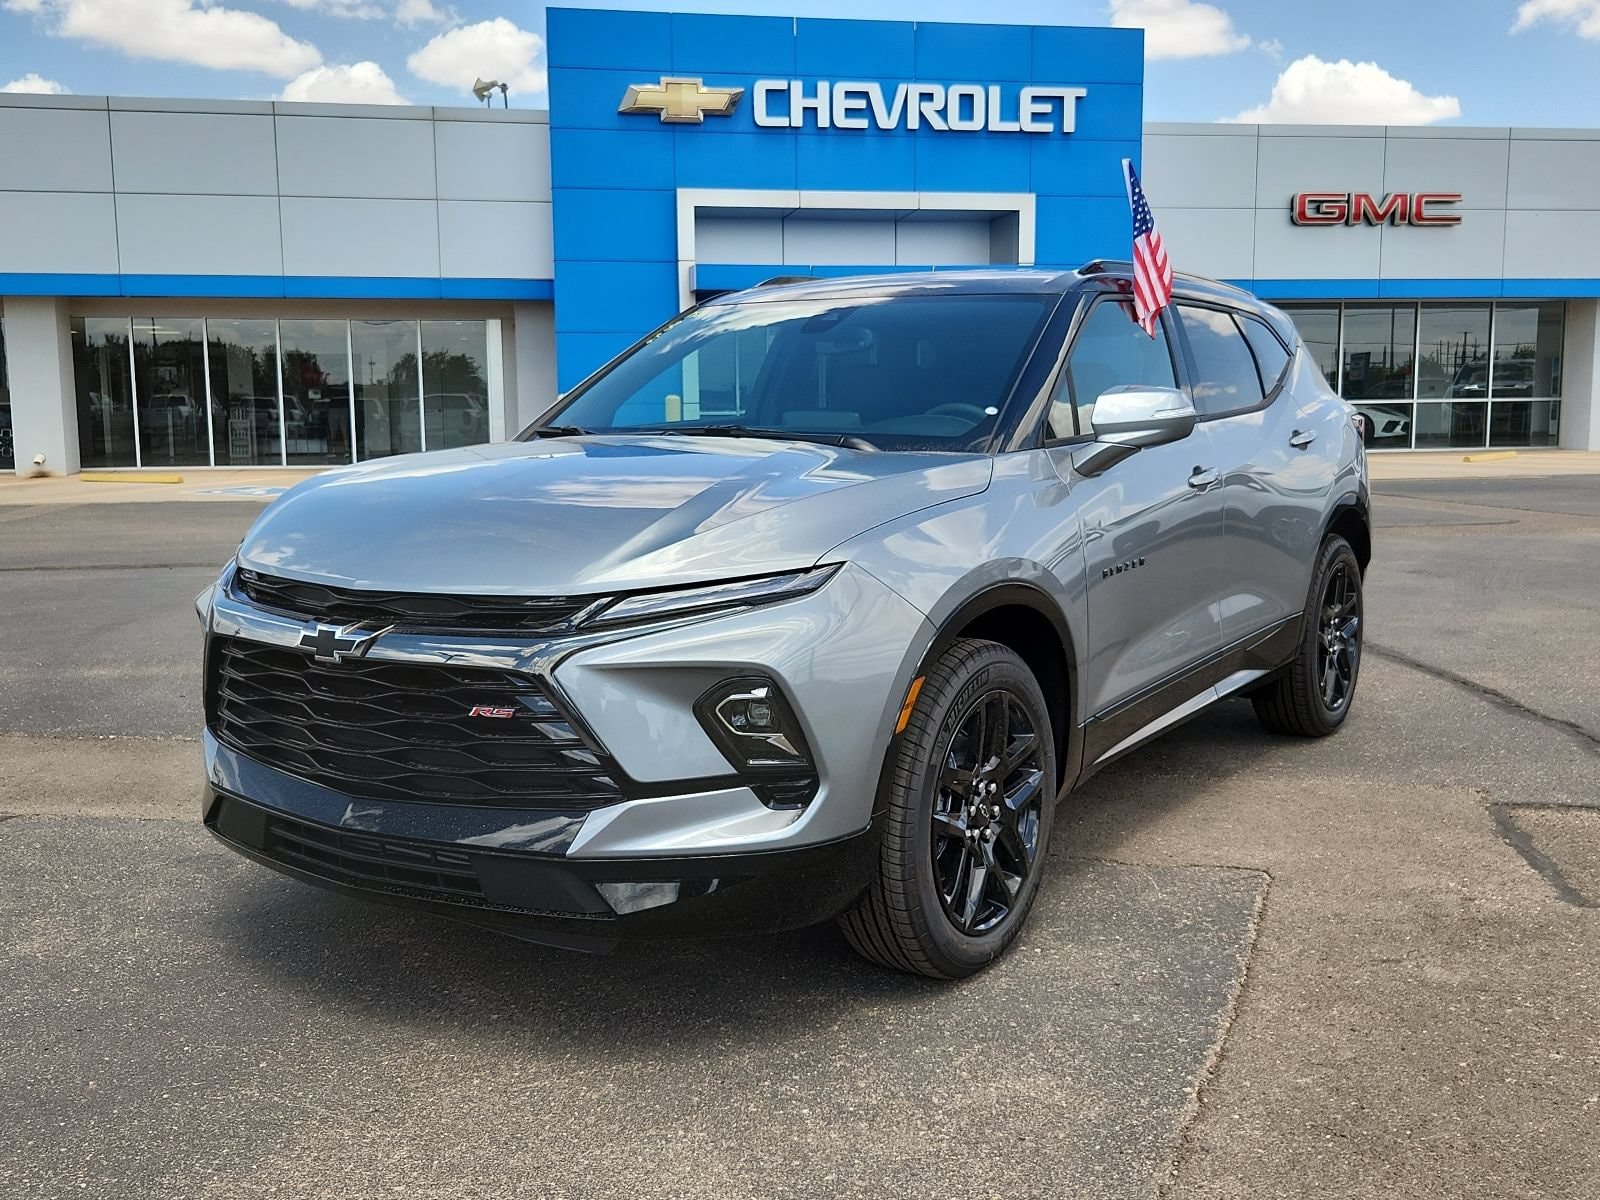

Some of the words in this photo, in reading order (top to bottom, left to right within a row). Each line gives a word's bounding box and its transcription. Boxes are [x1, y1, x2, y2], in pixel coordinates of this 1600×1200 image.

[753, 80, 1087, 133] CHEVROLET
[1292, 192, 1462, 226] GMC
[469, 706, 516, 719] RS
